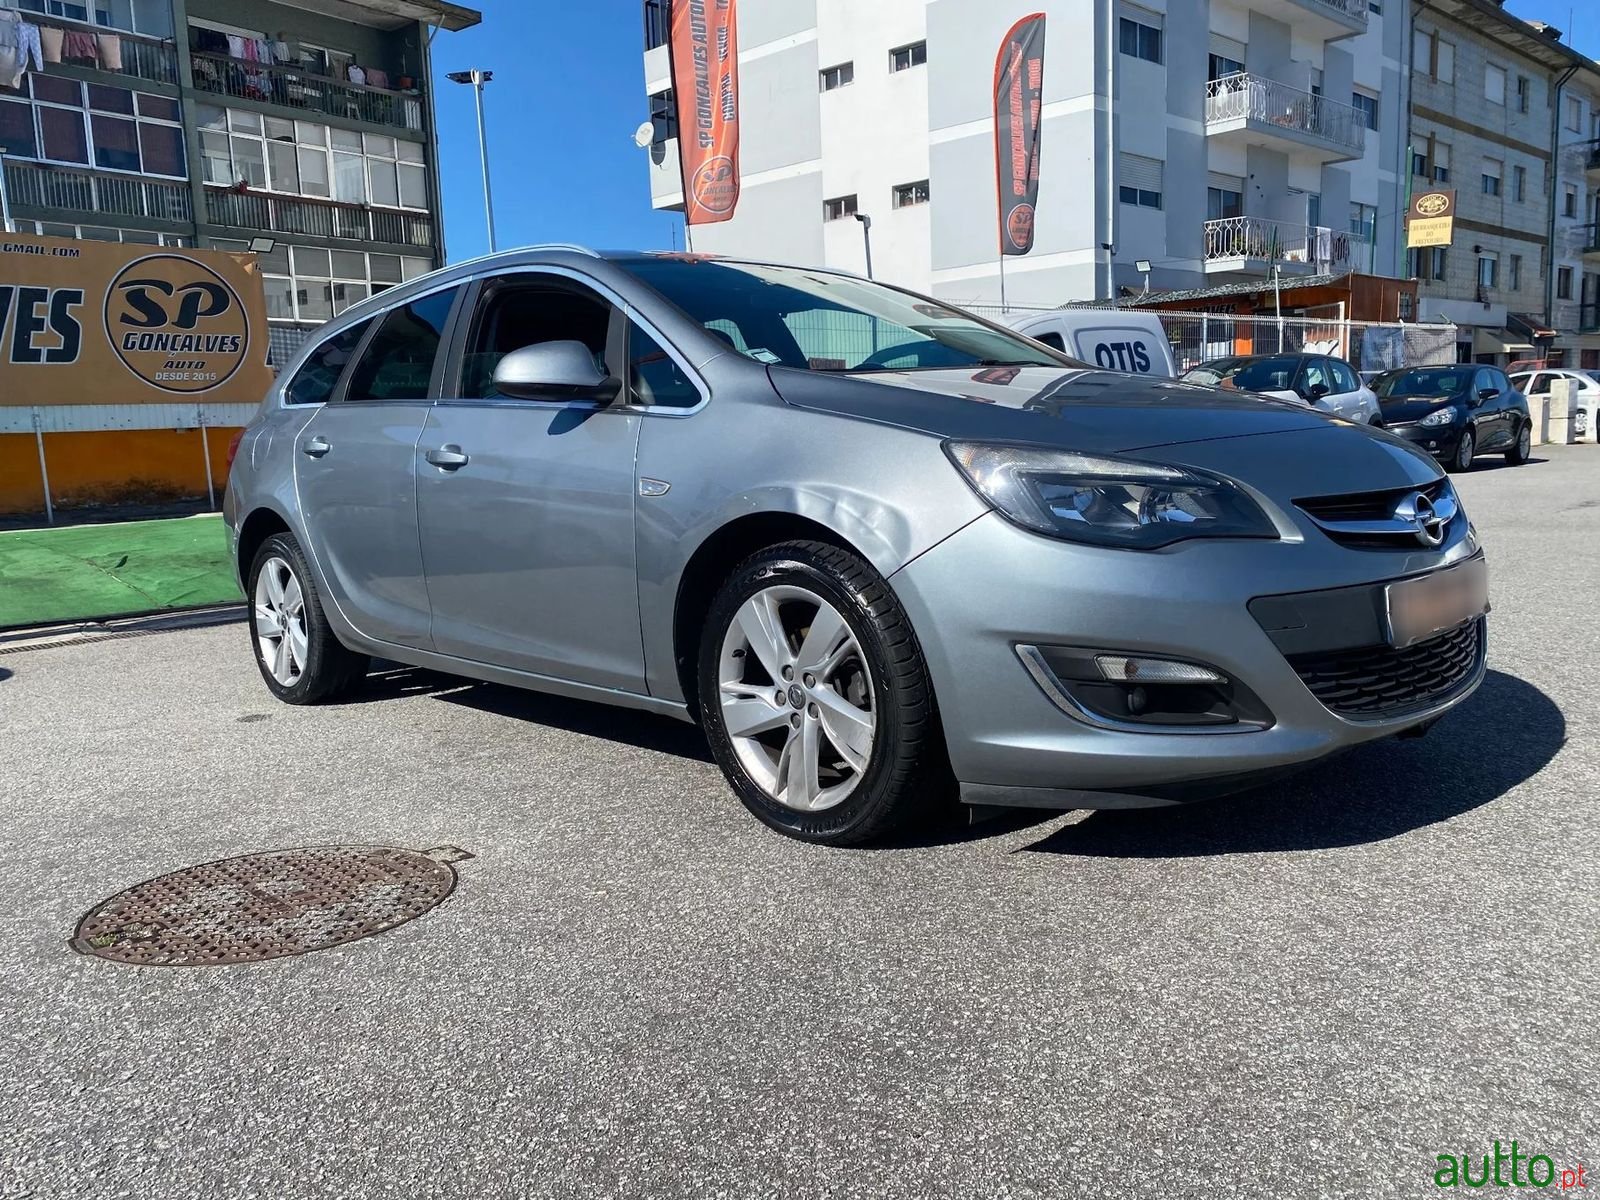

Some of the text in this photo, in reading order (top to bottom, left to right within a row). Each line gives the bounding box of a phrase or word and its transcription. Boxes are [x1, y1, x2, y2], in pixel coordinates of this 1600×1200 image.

[716, 26, 729, 63] VENDA
[721, 72, 735, 122] COMPRA
[698, 131, 714, 148] SP
[118, 279, 231, 329] SP
[122, 331, 242, 357] GONÇALVES
[1095, 341, 1150, 373] OTIS
[155, 372, 217, 381] DESDE 2015
[163, 360, 206, 370] AUTO
